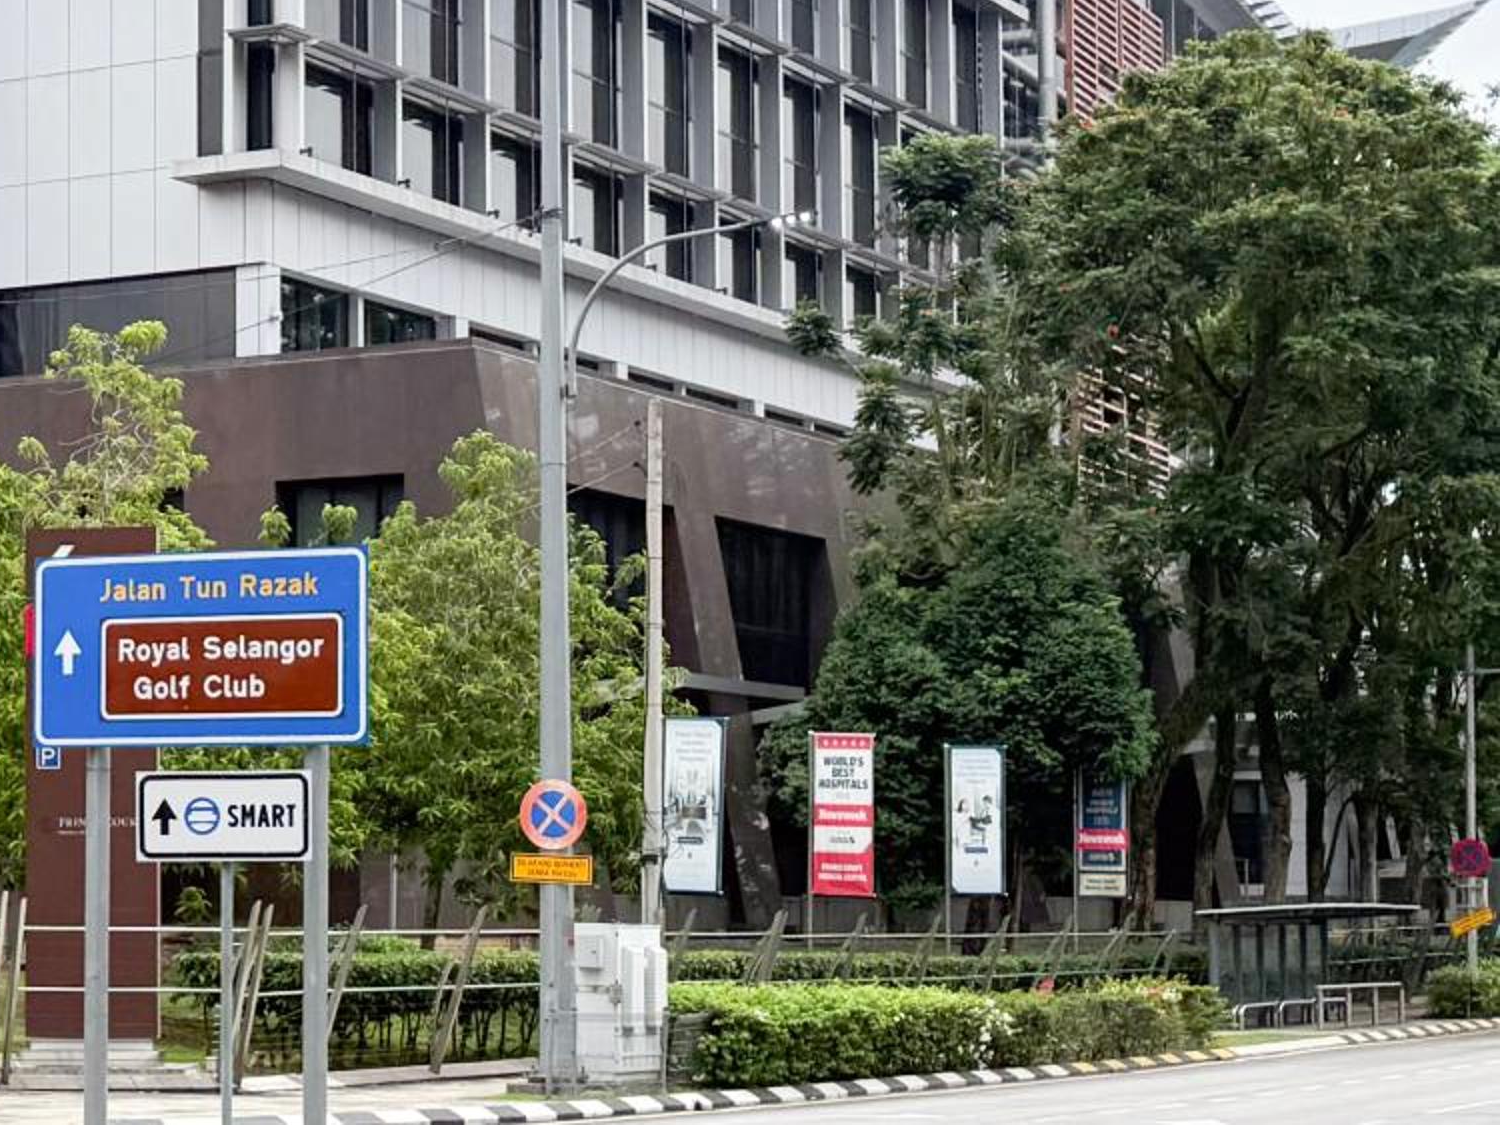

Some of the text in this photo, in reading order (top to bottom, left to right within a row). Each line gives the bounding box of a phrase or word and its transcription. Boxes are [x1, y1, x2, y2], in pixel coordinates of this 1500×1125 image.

[100, 572, 318, 603] Jalan Tun Razak
[118, 635, 324, 667] Royal Selangor
[134, 673, 265, 699] Golf Club
[227, 804, 296, 827] SMART
